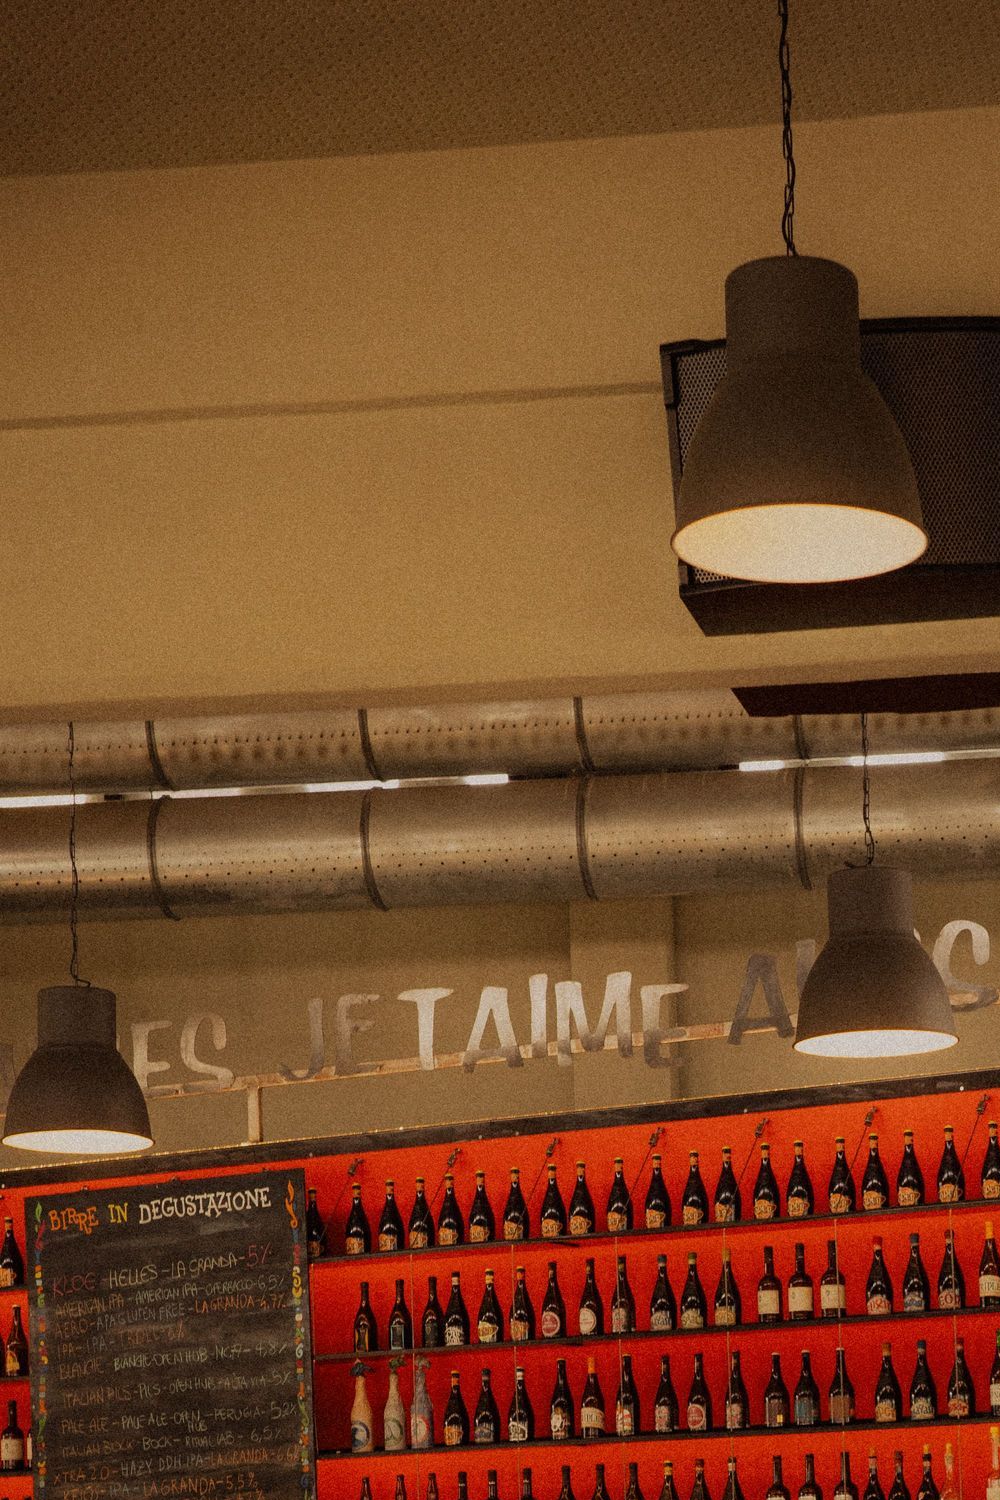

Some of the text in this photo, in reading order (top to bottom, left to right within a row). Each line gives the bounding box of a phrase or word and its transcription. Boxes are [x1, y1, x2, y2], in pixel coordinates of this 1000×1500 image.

[131, 1012, 235, 1096] ES
[278, 993, 380, 1081] JE
[48, 1187, 272, 1235] BIRRE IN DEGUSTAZIONE
[109, 1263, 158, 1289] HELLES
[171, 1260, 186, 1278] LA
[189, 1252, 238, 1279] GRANDA
[135, 1287, 180, 1305] AMERICAN
[147, 1412, 168, 1427] ALE
[142, 1436, 172, 1451] BOCK
